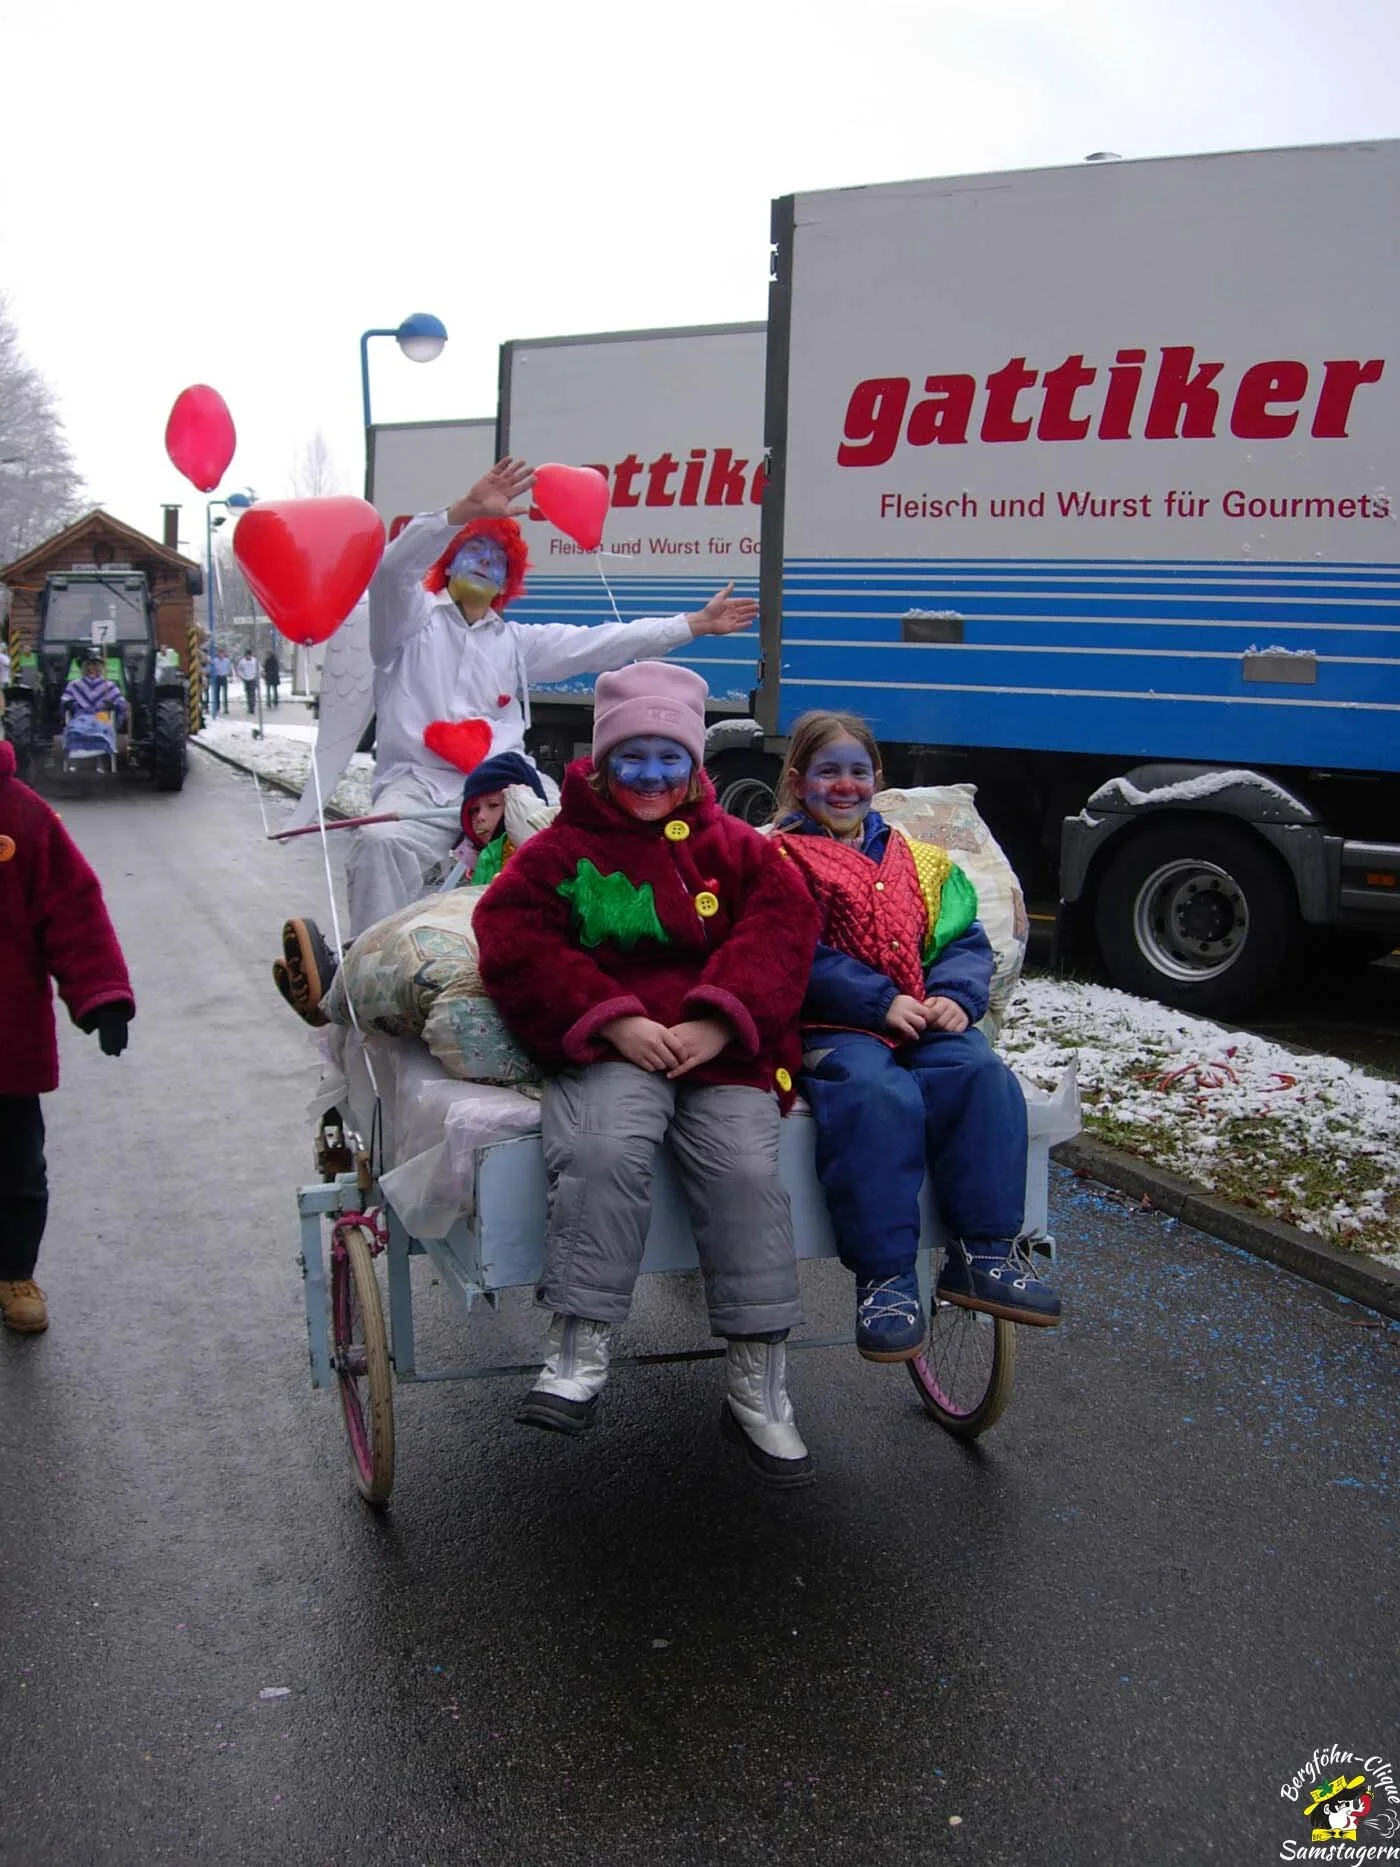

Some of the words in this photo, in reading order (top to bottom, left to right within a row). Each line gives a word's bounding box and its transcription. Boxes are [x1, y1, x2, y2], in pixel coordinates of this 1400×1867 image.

[836, 345, 1385, 468] gattiker
[879, 493, 978, 519] Fleisch
[989, 492, 1046, 519] und
[1056, 491, 1152, 519] Wurst
[1164, 490, 1210, 519] für
[1221, 488, 1390, 519] Gourmets
[611, 538, 642, 555] und
[649, 537, 701, 555] Wurst
[708, 536, 732, 555] für
[96, 625, 109, 642] 7
